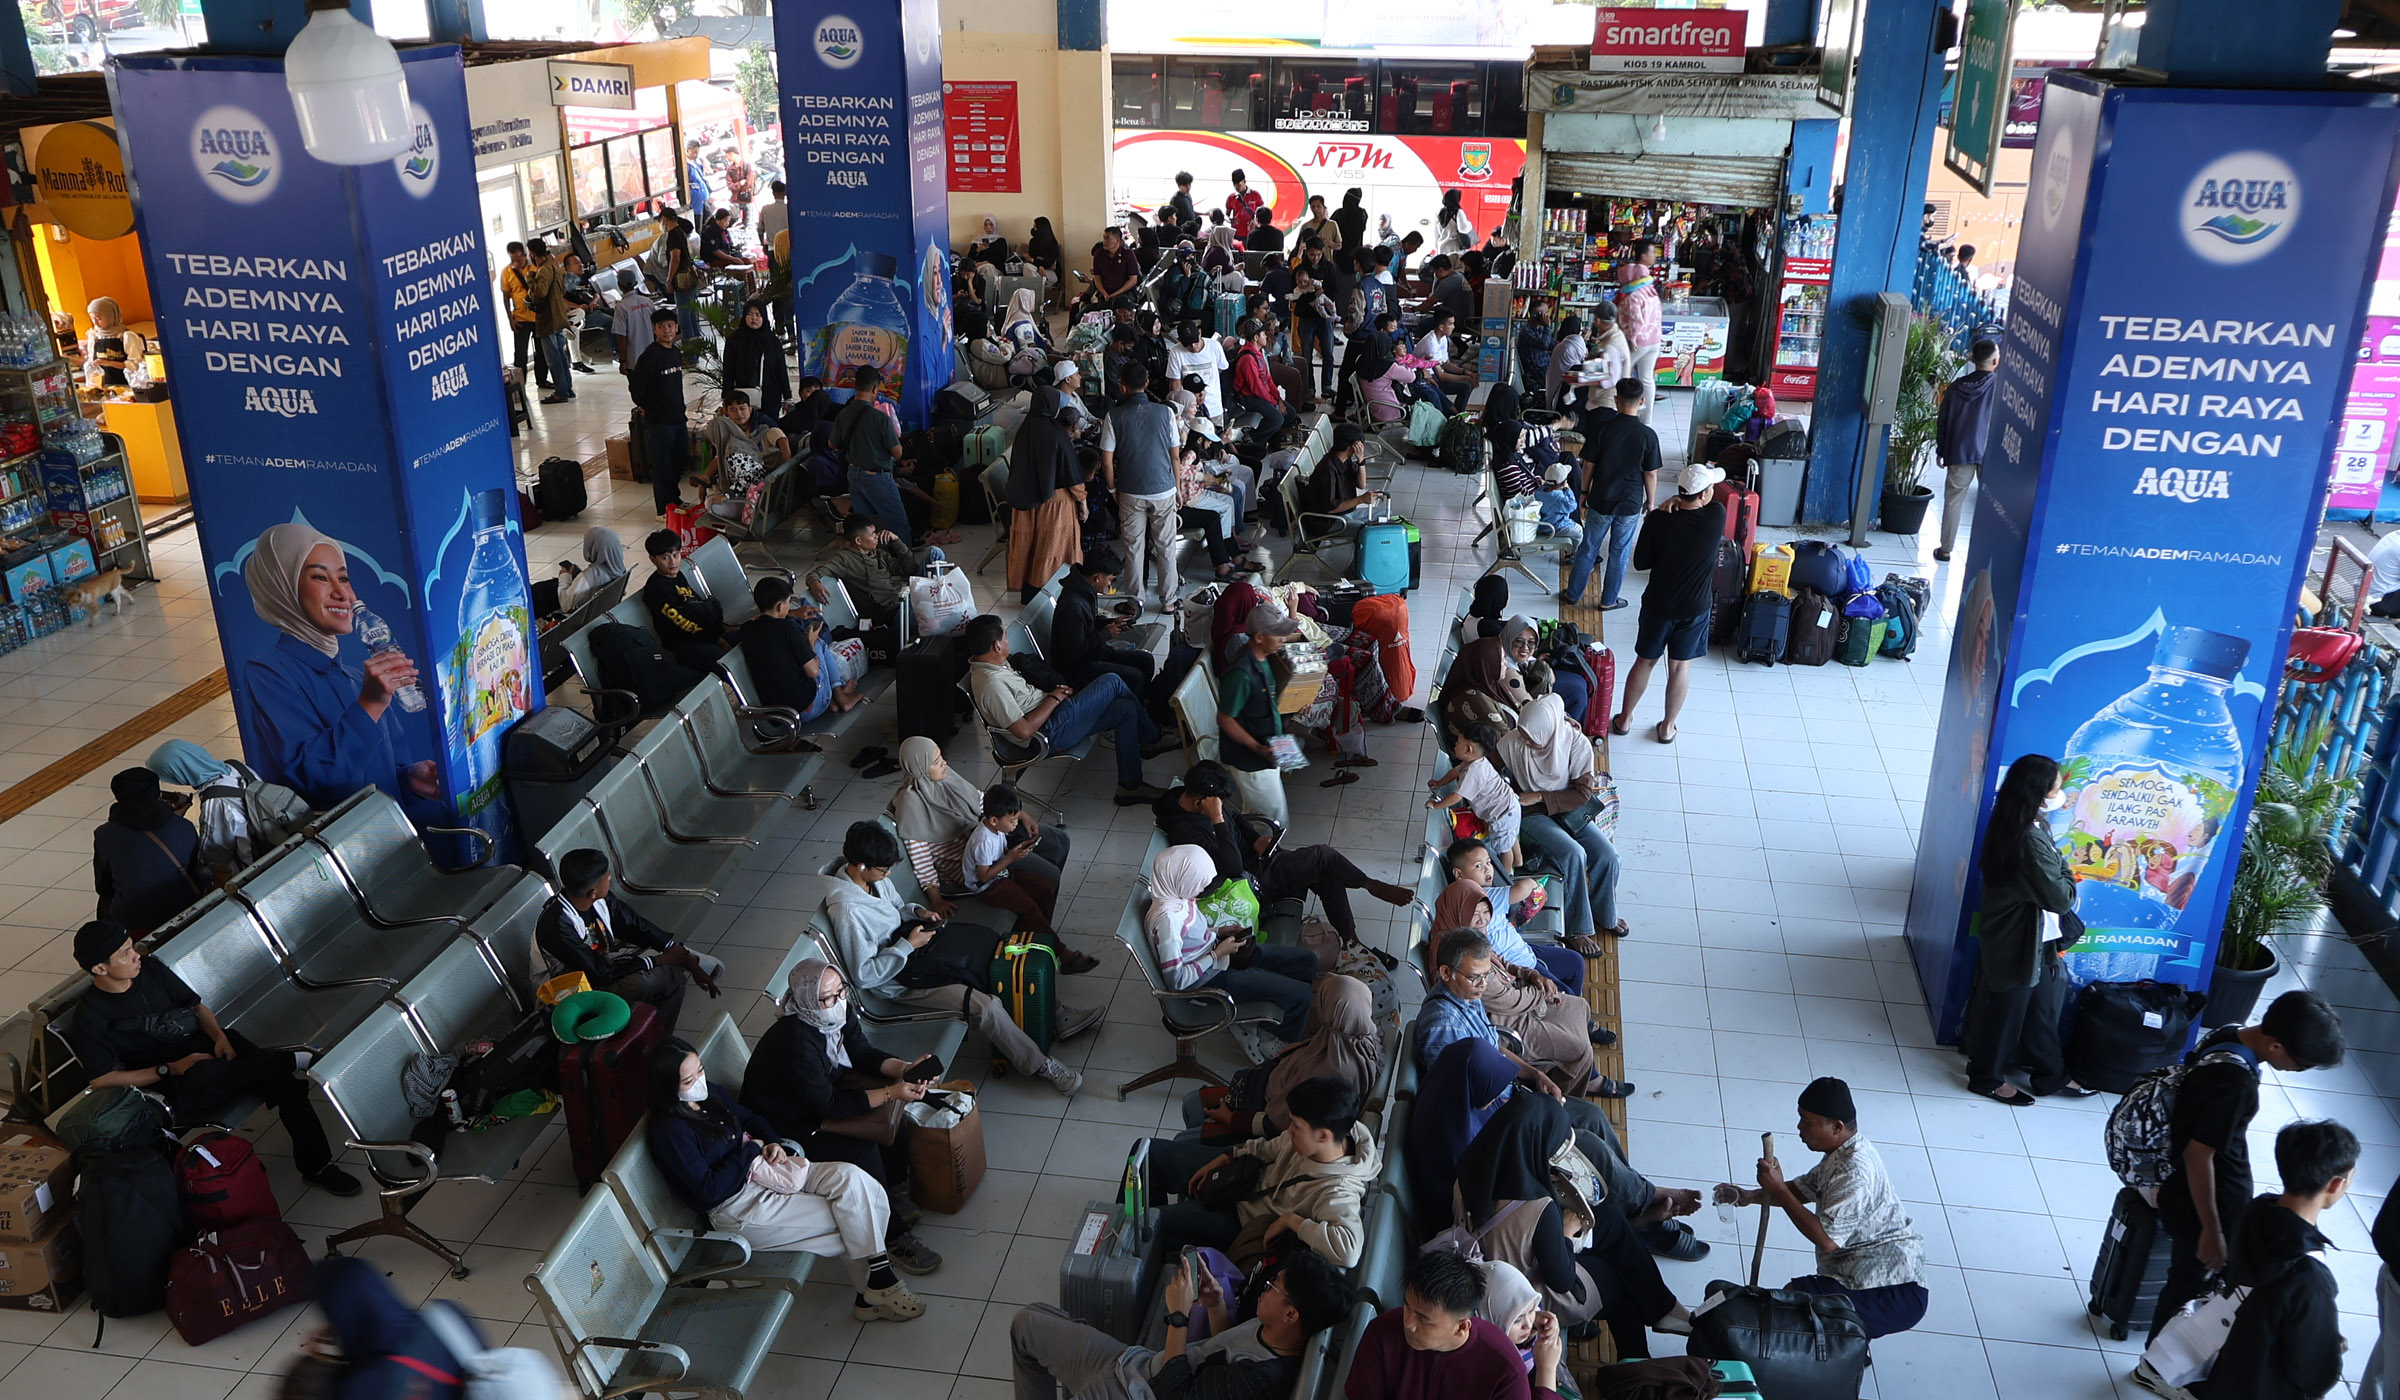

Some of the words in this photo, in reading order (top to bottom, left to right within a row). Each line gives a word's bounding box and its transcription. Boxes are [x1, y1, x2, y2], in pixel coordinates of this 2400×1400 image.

[818, 28, 858, 46] AQUA
[1606, 21, 1730, 46] smartfren
[1624, 60, 1648, 68] KIOS
[1651, 60, 1662, 68] 19
[1665, 60, 1707, 69] KAMROL
[571, 77, 629, 96] DAMRI
[1581, 79, 1628, 88] PASTIKAN
[1630, 79, 1654, 88] FISIK
[1656, 79, 1684, 87] ANDA
[1686, 79, 1718, 87] SEHAT
[1721, 79, 1741, 87] DA
[1745, 79, 1777, 89] PRIMA
[791, 95, 894, 109] TEBARKAN
[910, 90, 941, 109] TEBARKAN
[798, 114, 889, 128] ADEMNYA
[913, 108, 940, 127] ADEMNYA
[199, 128, 270, 160] AQUA
[798, 133, 840, 145] HARI
[845, 133, 891, 146] RAYA
[913, 129, 927, 144] HARI
[927, 126, 941, 140] RAYA
[807, 151, 885, 164] DENGAN
[916, 145, 940, 162] DENGAN
[1302, 141, 1395, 169] NPM
[1463, 144, 1489, 152] NPM
[41, 168, 88, 191] Mamma
[826, 170, 869, 189] AQUA
[1333, 169, 1365, 179] V55
[2193, 178, 2288, 214] AQUA
[800, 210, 899, 220] #TEMANADEMRAMADAN
[382, 230, 476, 278] TEBARKAN
[165, 253, 348, 281] TEBARKAN
[394, 263, 476, 310] ADEMNYA
[183, 286, 345, 314] ADEMNYA
[2014, 276, 2062, 329] TEBARKAN
[396, 309, 438, 342] HARI
[439, 294, 480, 325] RAYA
[185, 318, 261, 342] HARI
[267, 322, 350, 346] RAYA
[2009, 311, 2050, 364] ADEMNYA
[2099, 315, 2336, 348] TEBARKAN
[408, 325, 478, 371] DENGAN
[205, 351, 342, 377] DENGAN
[2004, 344, 2025, 379] HARI
[2024, 362, 2045, 399] RAYA
[2099, 354, 2312, 385] ADEMNYA
[431, 363, 470, 401] AQUA
[244, 386, 318, 418] AQUA
[2002, 380, 2037, 431] DENGAN
[2091, 390, 2190, 416] HARI
[2198, 394, 2305, 421] RAYA
[2361, 424, 2372, 435] 7
[412, 417, 500, 470] #TEMANADEMRAMADAN
[2102, 427, 2283, 457] DENGAN
[205, 453, 377, 473] #TEMANADEMRAMADAN
[2346, 456, 2367, 468] 28
[2132, 467, 2231, 503] AQUA
[2055, 543, 2282, 566] #TEMANADEMRAMADAN
[2118, 777, 2174, 793] SEMOGA
[471, 787, 491, 812] AQUA
[2100, 789, 2156, 803] SENDALKU
[2157, 795, 2185, 808] GAK
[2107, 802, 2142, 814] ILANG
[2145, 806, 2168, 818] PAS
[2105, 814, 2161, 830] TARAWEH
[2095, 935, 2179, 949] RAMADAN
